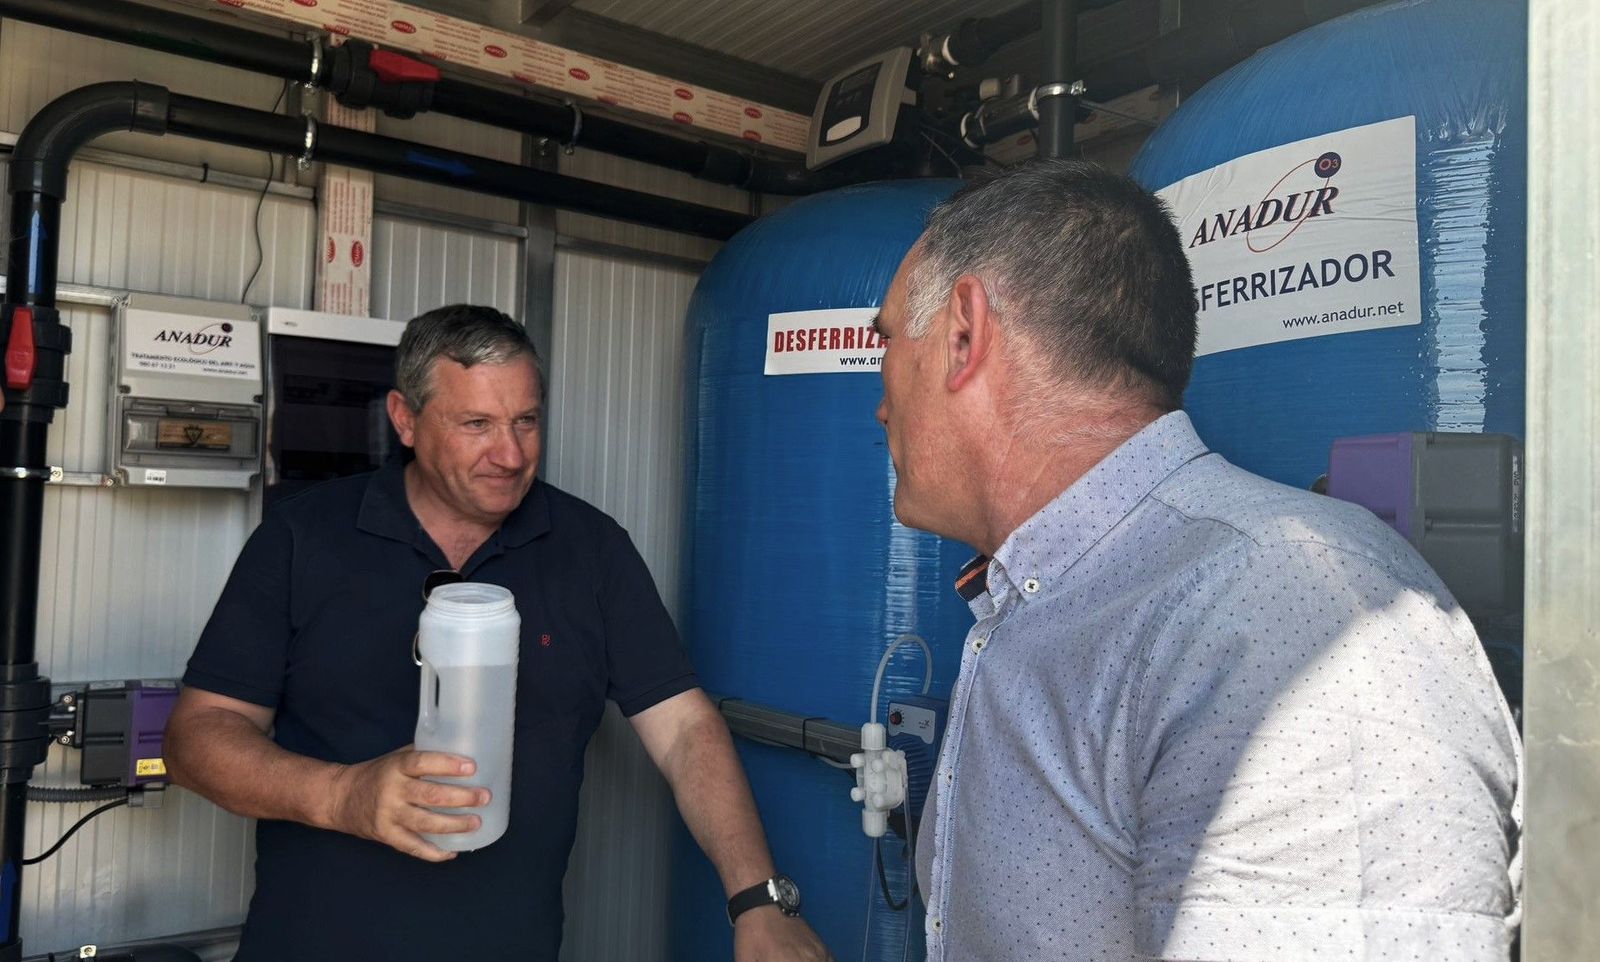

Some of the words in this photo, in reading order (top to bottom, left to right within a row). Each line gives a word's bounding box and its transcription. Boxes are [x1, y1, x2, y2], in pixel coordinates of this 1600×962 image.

[1188, 186, 1339, 248] ANADUR
[1282, 301, 1405, 328] www.anadur.net
[155, 330, 232, 347] ANADUR
[775, 327, 889, 352] DESFERRIZA
